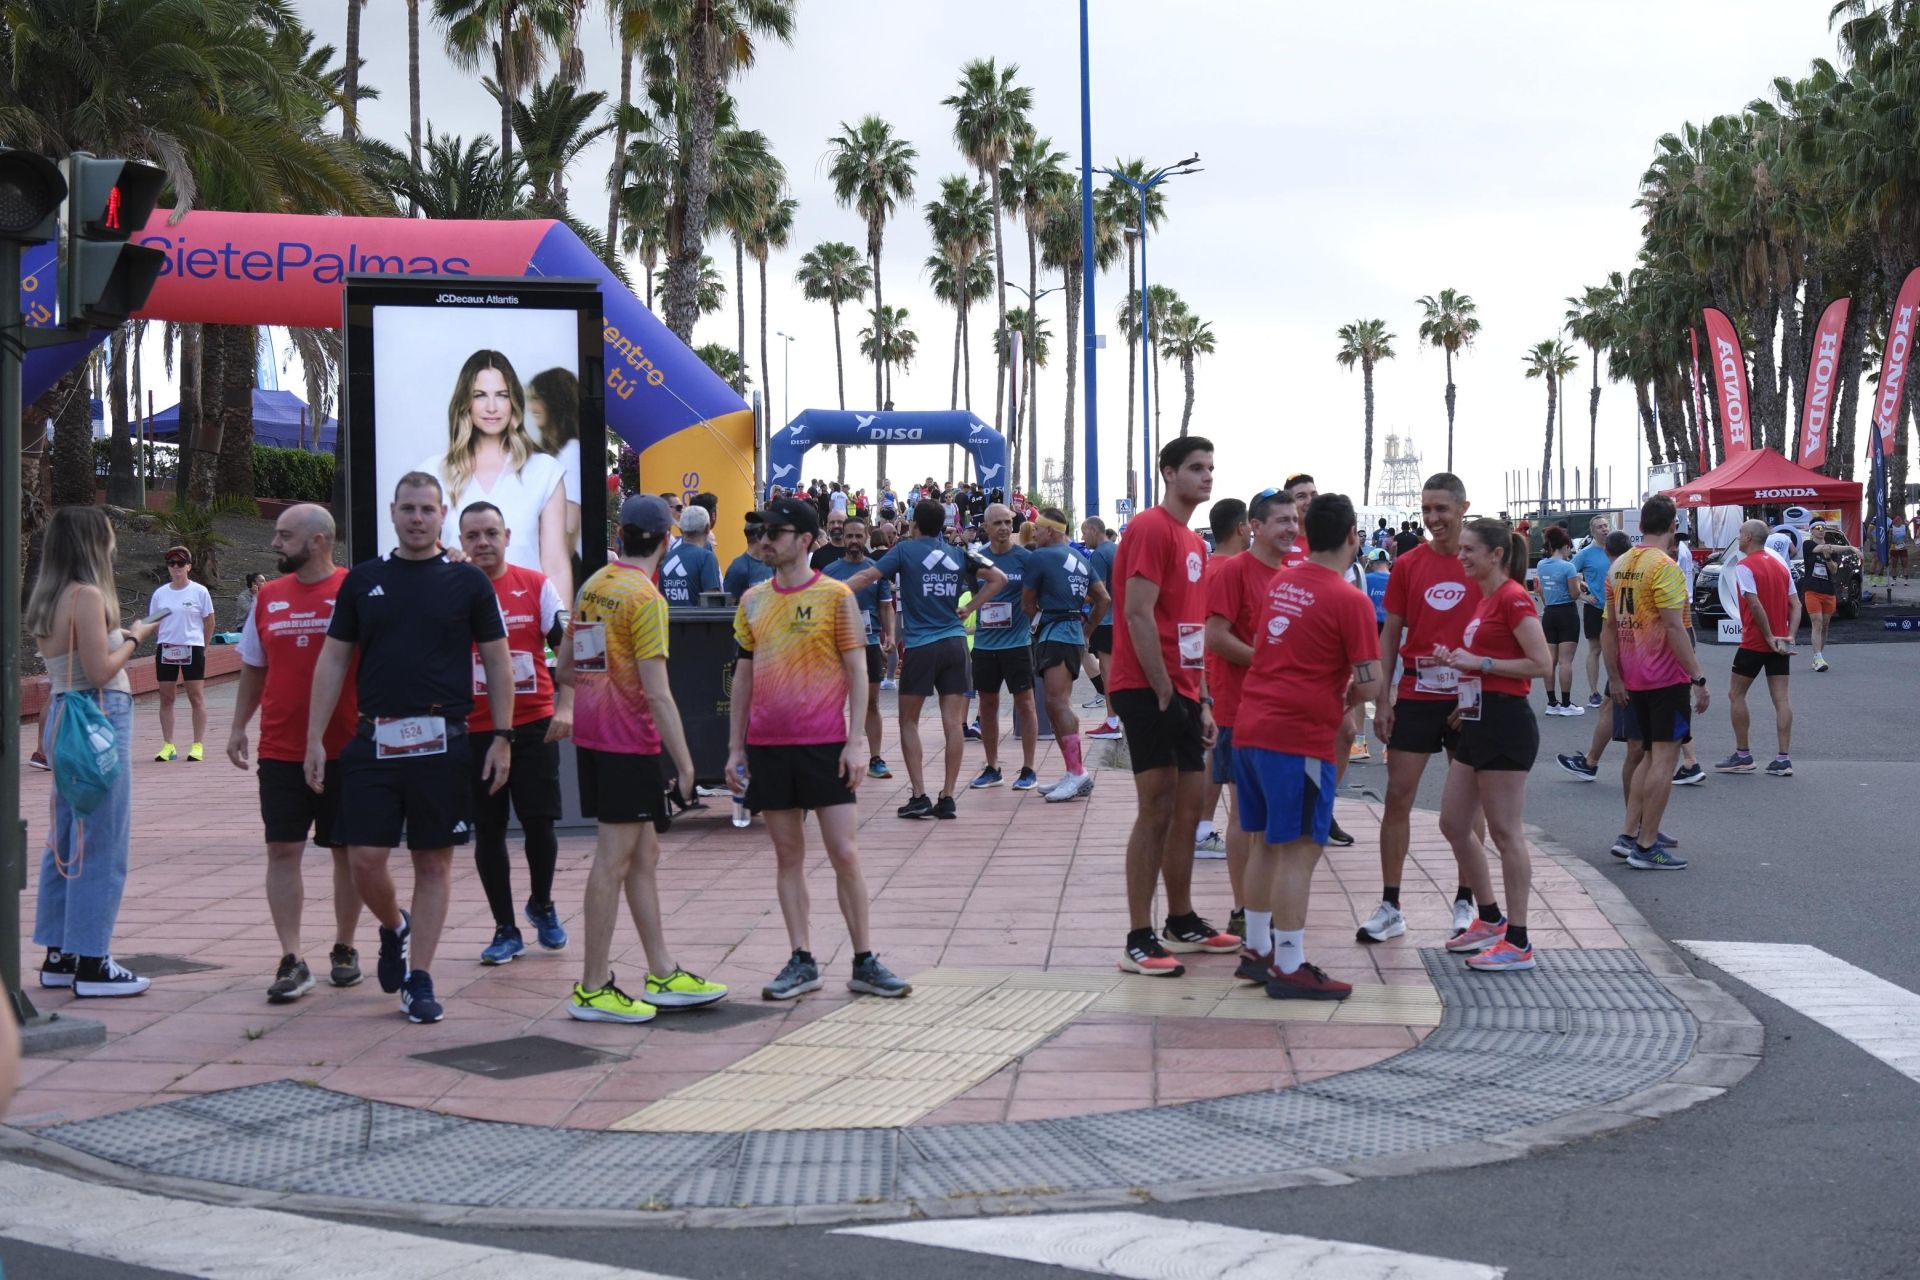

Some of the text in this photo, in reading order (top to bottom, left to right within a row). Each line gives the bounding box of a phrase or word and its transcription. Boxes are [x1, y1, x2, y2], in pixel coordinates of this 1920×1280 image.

[436, 294, 519, 304] JCDecaux Atlantis
[1878, 305, 1913, 440] HONDA
[607, 366, 638, 400] tú
[1805, 331, 1837, 458] HONDA
[1754, 487, 1819, 499] HONDA
[922, 573, 958, 583] GRUPO
[664, 588, 689, 601] FSM
[1427, 588, 1467, 601] ICOT
[1619, 587, 1635, 615] N
[795, 606, 812, 620] M
[1722, 624, 1743, 635] Volk
[399, 724, 423, 739] 1524
